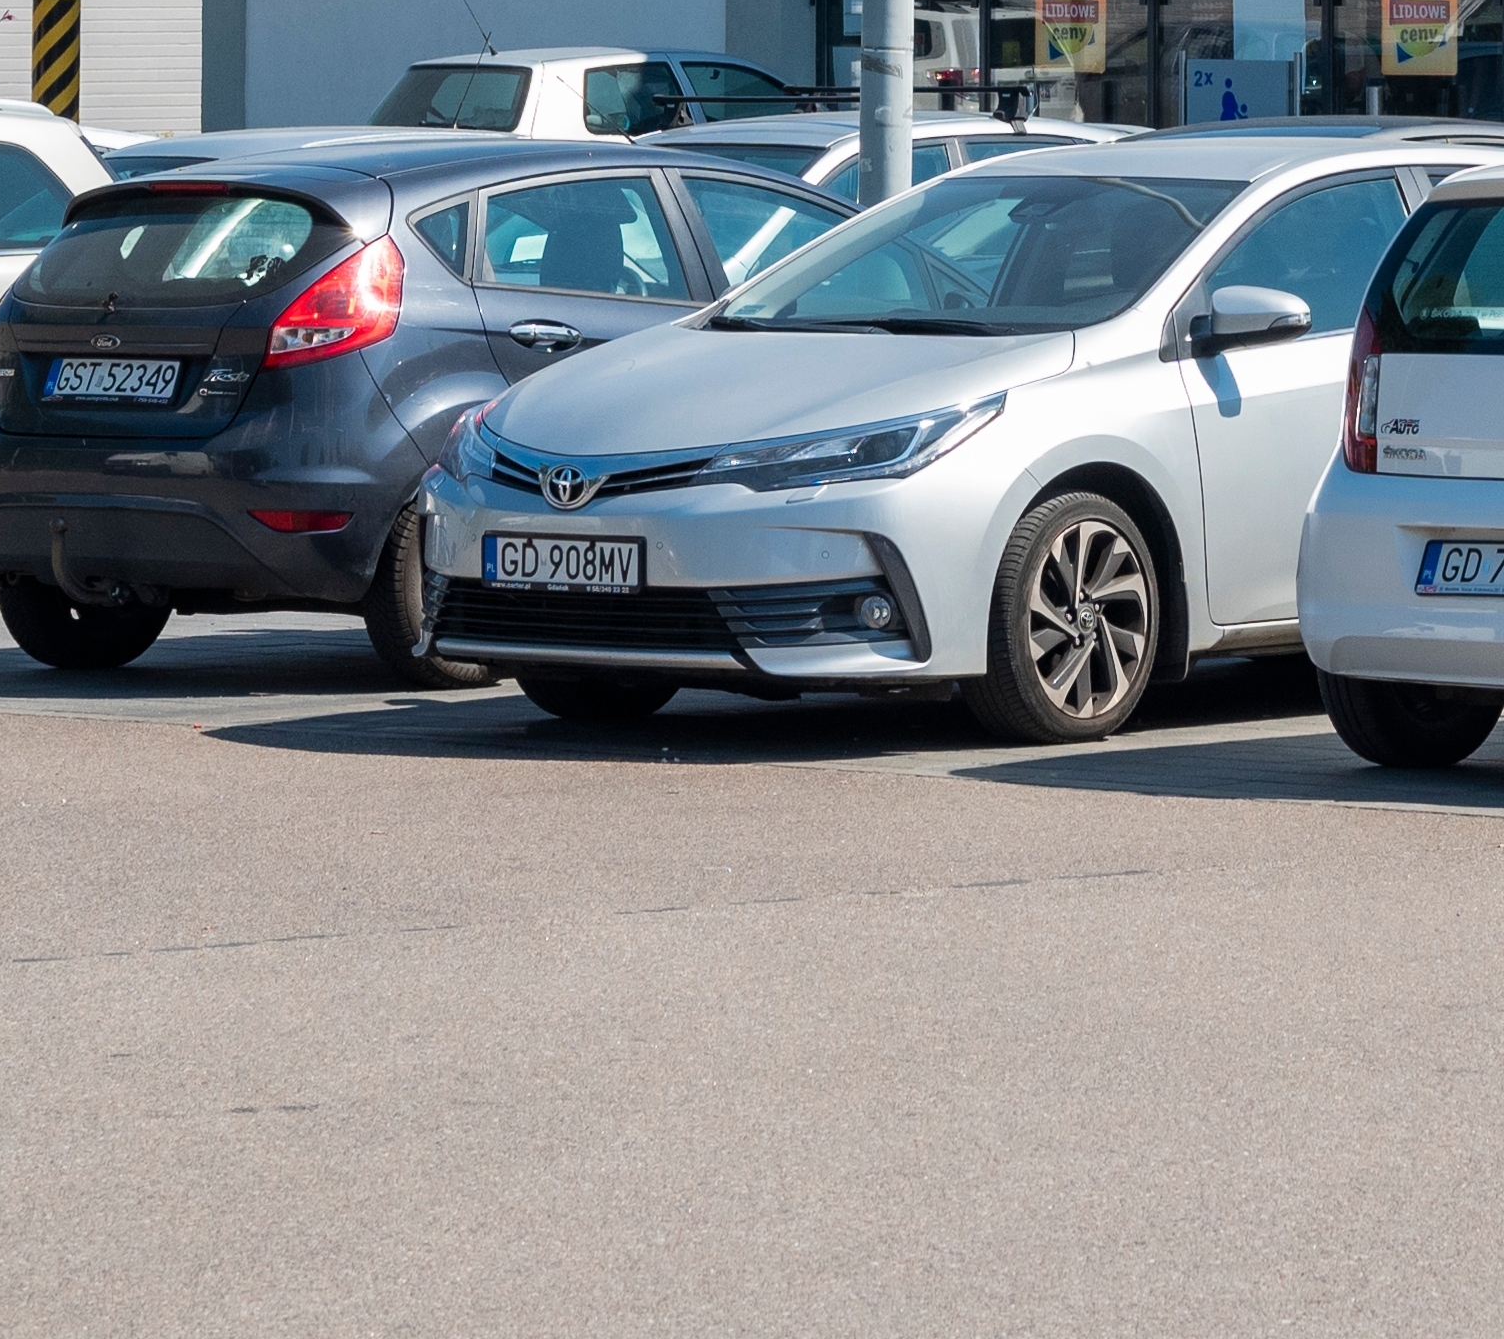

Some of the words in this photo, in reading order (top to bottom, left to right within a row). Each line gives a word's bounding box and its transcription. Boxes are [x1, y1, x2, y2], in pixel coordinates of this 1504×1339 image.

[1045, 3, 1096, 19] LIDLOWE
[1392, 3, 1447, 19] LIDLOWE
[1052, 26, 1087, 42] ceny
[1399, 27, 1439, 44] ceny
[1193, 70, 1213, 87] 2x
[56, 361, 103, 392] GST
[102, 362, 176, 395] 52349
[1382, 445, 1427, 461] ŠKODA
[486, 563, 496, 572] PL
[501, 541, 539, 578] GD
[549, 544, 633, 583] 908MV
[1441, 547, 1483, 583] GD
[1422, 569, 1433, 579] PL
